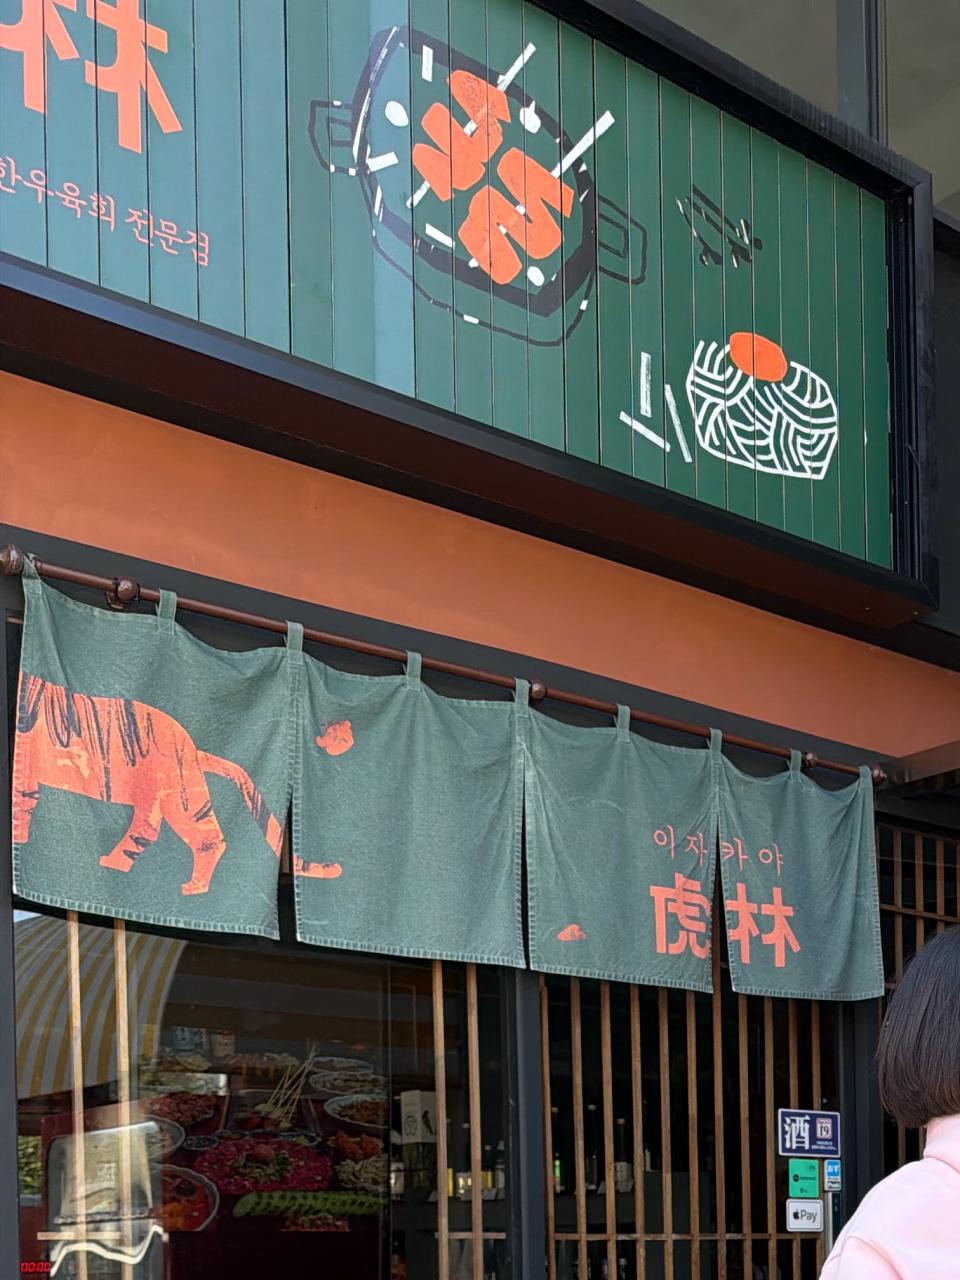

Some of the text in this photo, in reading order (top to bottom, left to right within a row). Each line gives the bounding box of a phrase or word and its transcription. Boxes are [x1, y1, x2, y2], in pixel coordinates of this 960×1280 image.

[125, 207, 209, 267] 전문점
[653, 824, 785, 877] 이자카야
[784, 1114, 811, 1150] 酒
[819, 1126, 830, 1136] 19
[800, 1209, 818, 1223] Pay
